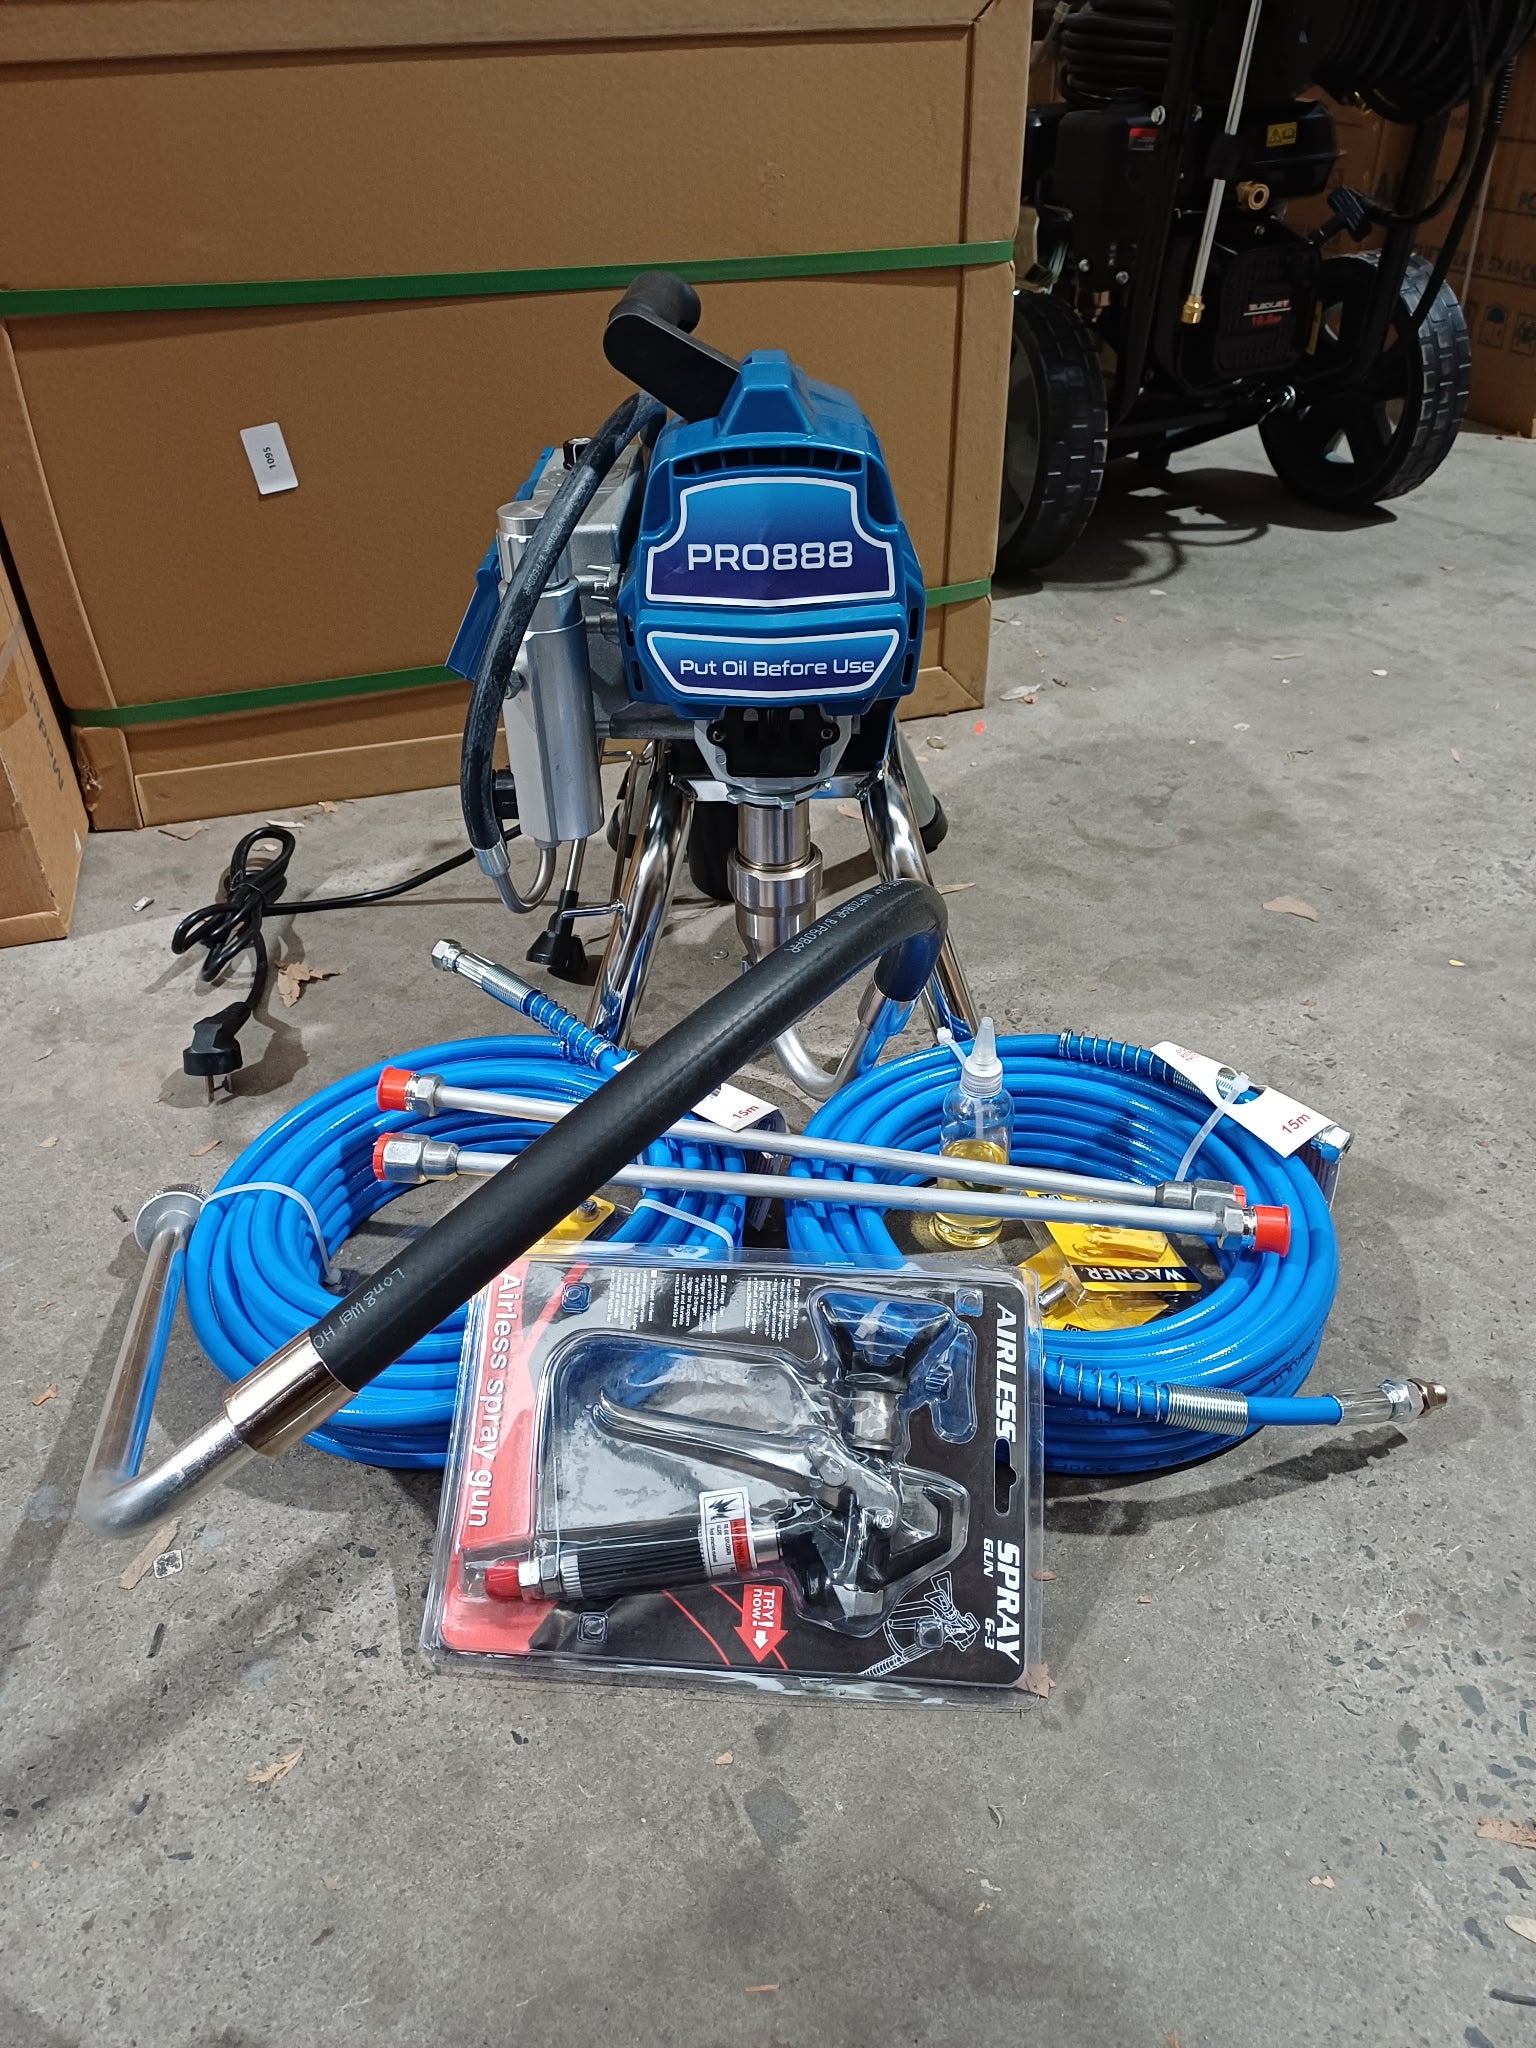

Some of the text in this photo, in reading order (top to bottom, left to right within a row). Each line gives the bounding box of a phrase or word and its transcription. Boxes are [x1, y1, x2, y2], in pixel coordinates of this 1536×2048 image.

[263, 446, 276, 469] 1095
[687, 541, 853, 571] PRO888
[680, 658, 875, 677] Put Oil Before Use
[733, 1105, 760, 1119] 15m
[1282, 1114, 1311, 1134] 15m
[468, 1272, 522, 1527] Airless spray gun
[996, 1302, 1020, 1665] AIRLESS SPRAY
[763, 1589, 775, 1620] TRY
[983, 1538, 995, 1650] GUN G-3
